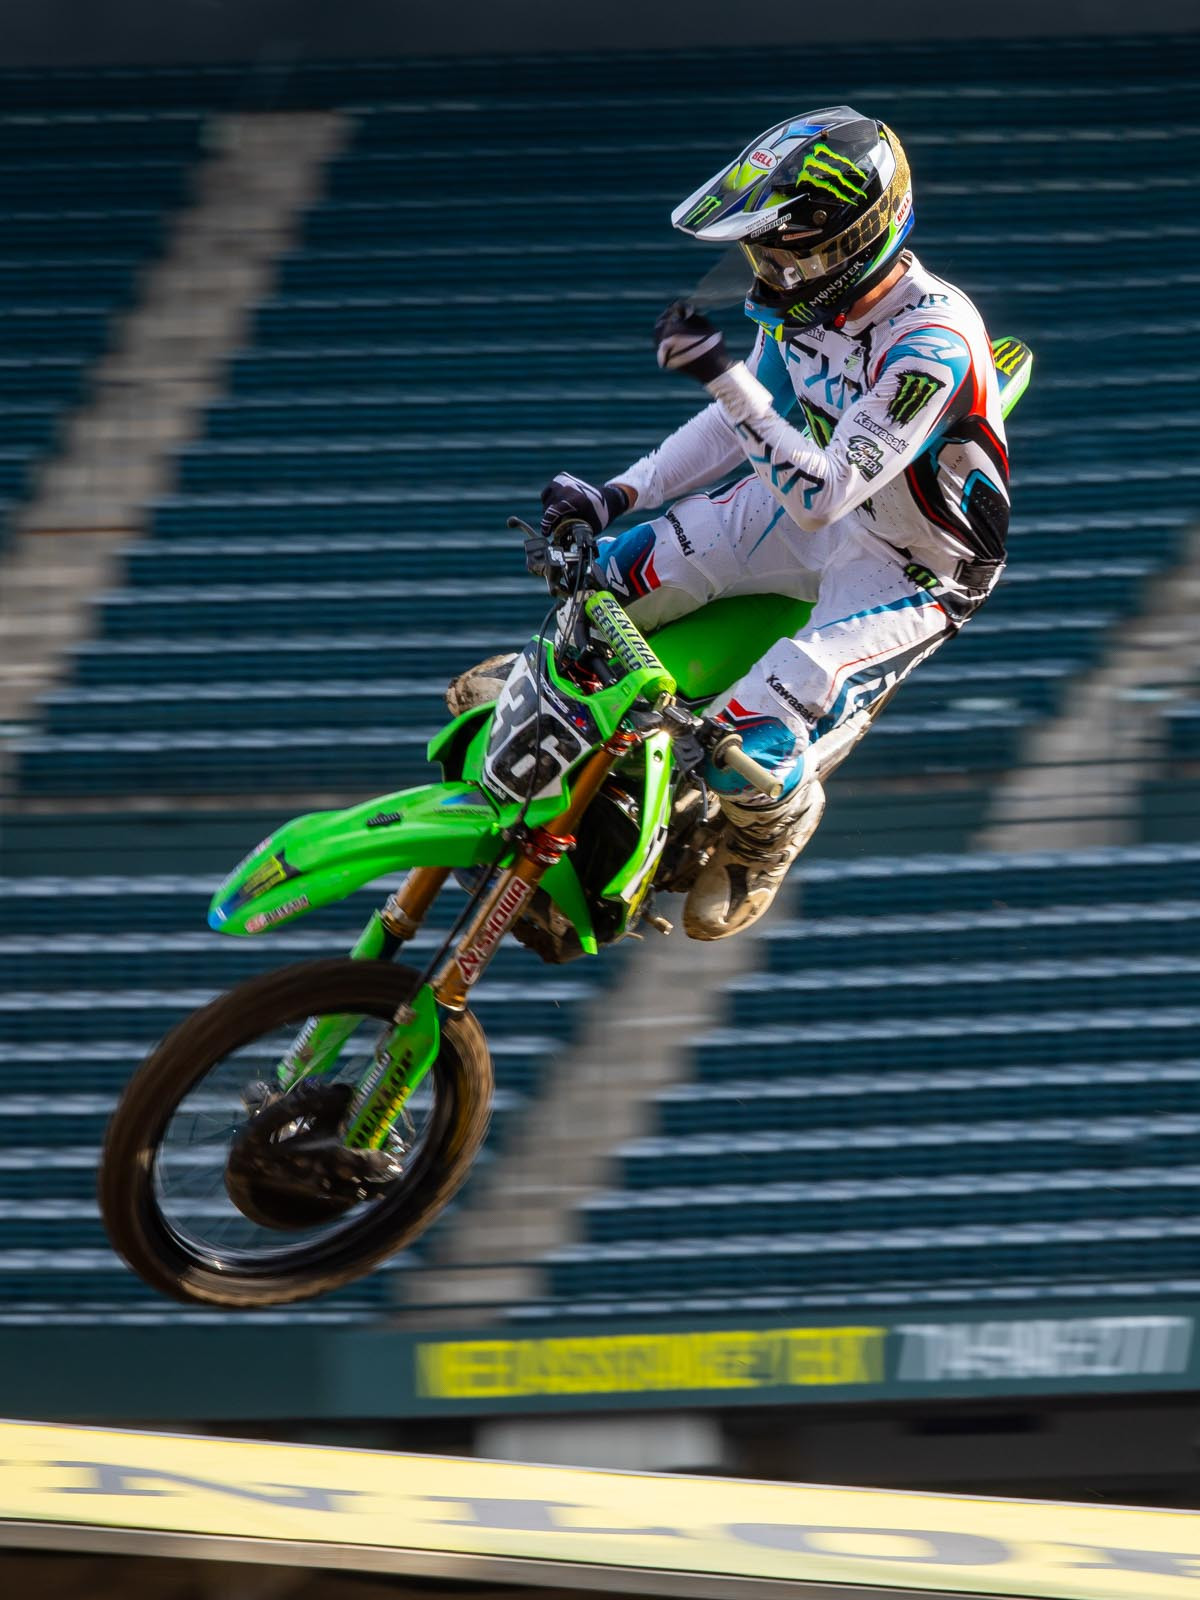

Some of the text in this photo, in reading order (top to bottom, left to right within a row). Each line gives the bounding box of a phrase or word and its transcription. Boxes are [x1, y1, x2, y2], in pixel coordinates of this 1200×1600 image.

[751, 151, 772, 167] BELL
[809, 260, 864, 308] MONSTER
[850, 435, 882, 461] TEAM
[853, 411, 909, 455] Kawasaki
[848, 450, 881, 475] GREEN
[664, 510, 695, 556] awasaki
[591, 604, 643, 671] RENTHA
[766, 673, 819, 725] Kawasaki
[475, 878, 529, 954] SHOWA
